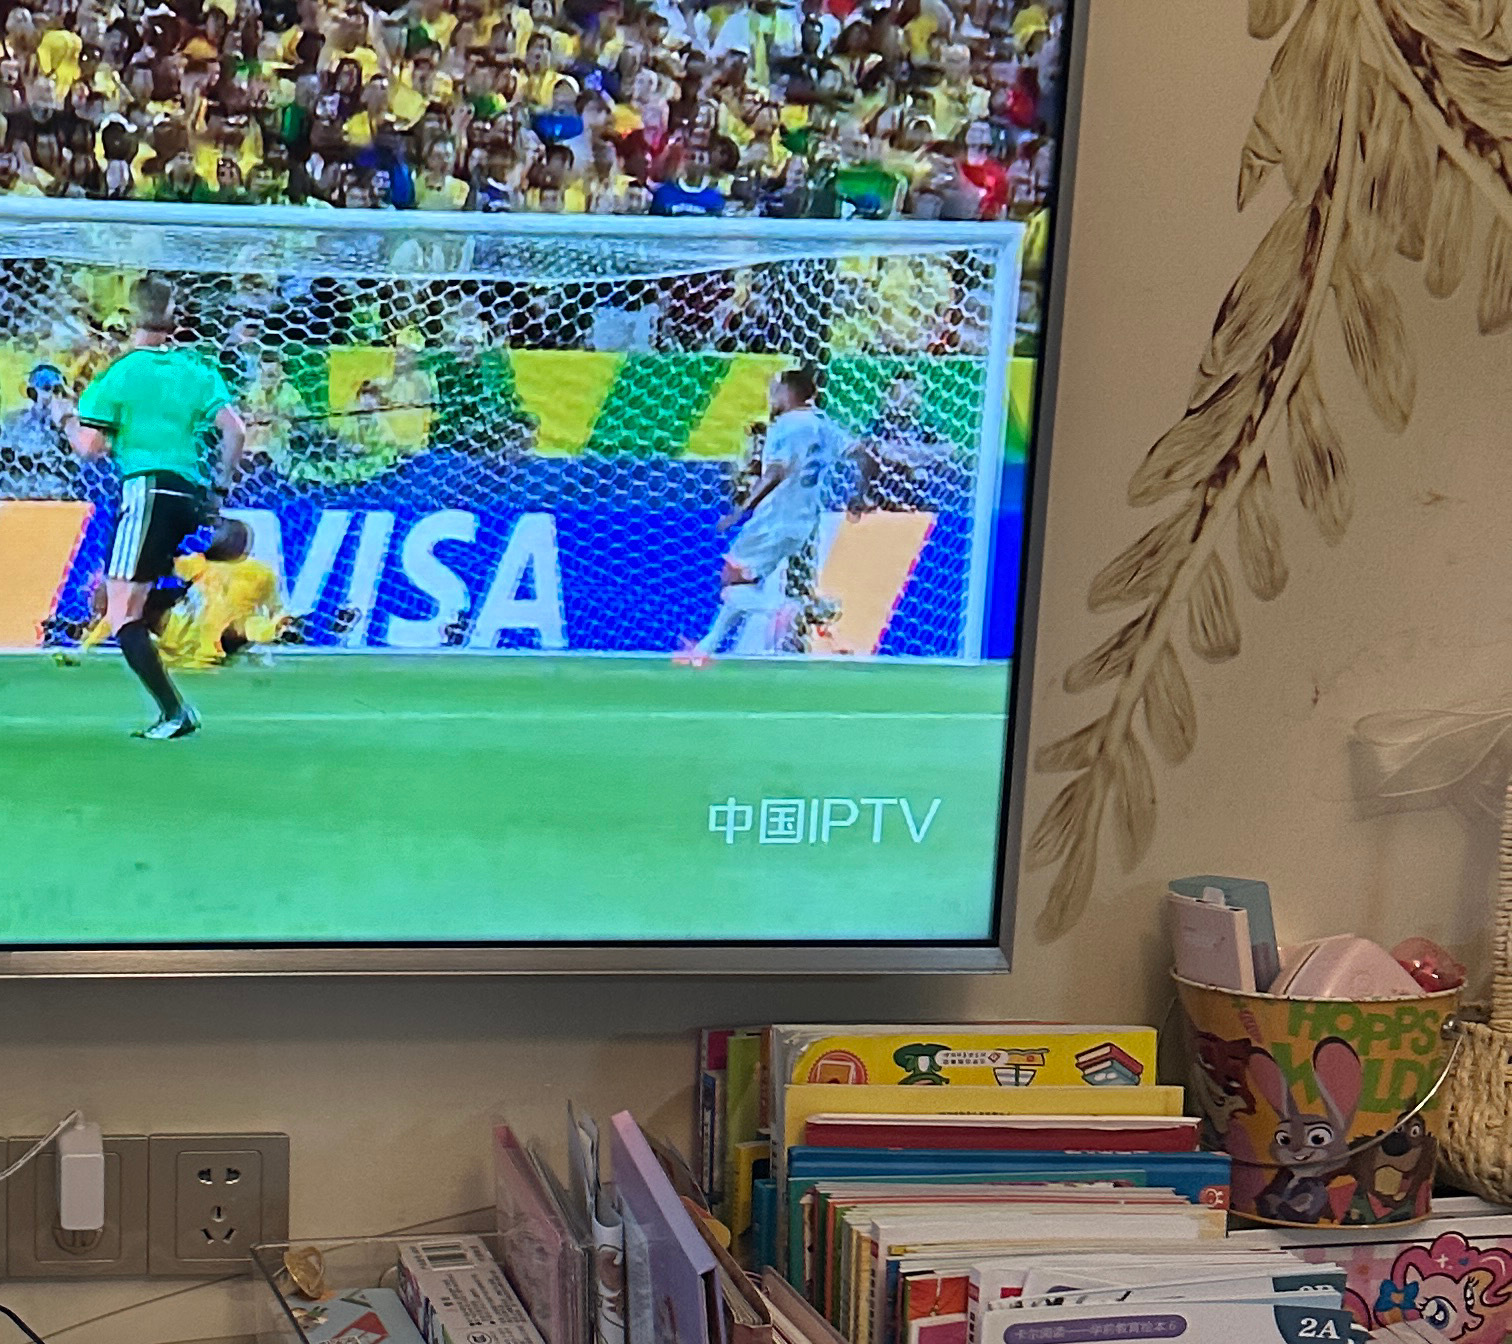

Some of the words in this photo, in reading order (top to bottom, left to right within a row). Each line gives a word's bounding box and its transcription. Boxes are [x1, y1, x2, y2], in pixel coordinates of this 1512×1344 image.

[219, 508, 570, 649] VISA
[708, 796, 943, 845] 中国IPTV
[1288, 1000, 1439, 1056] HOPPS
[1297, 1316, 1341, 1340] 2A
